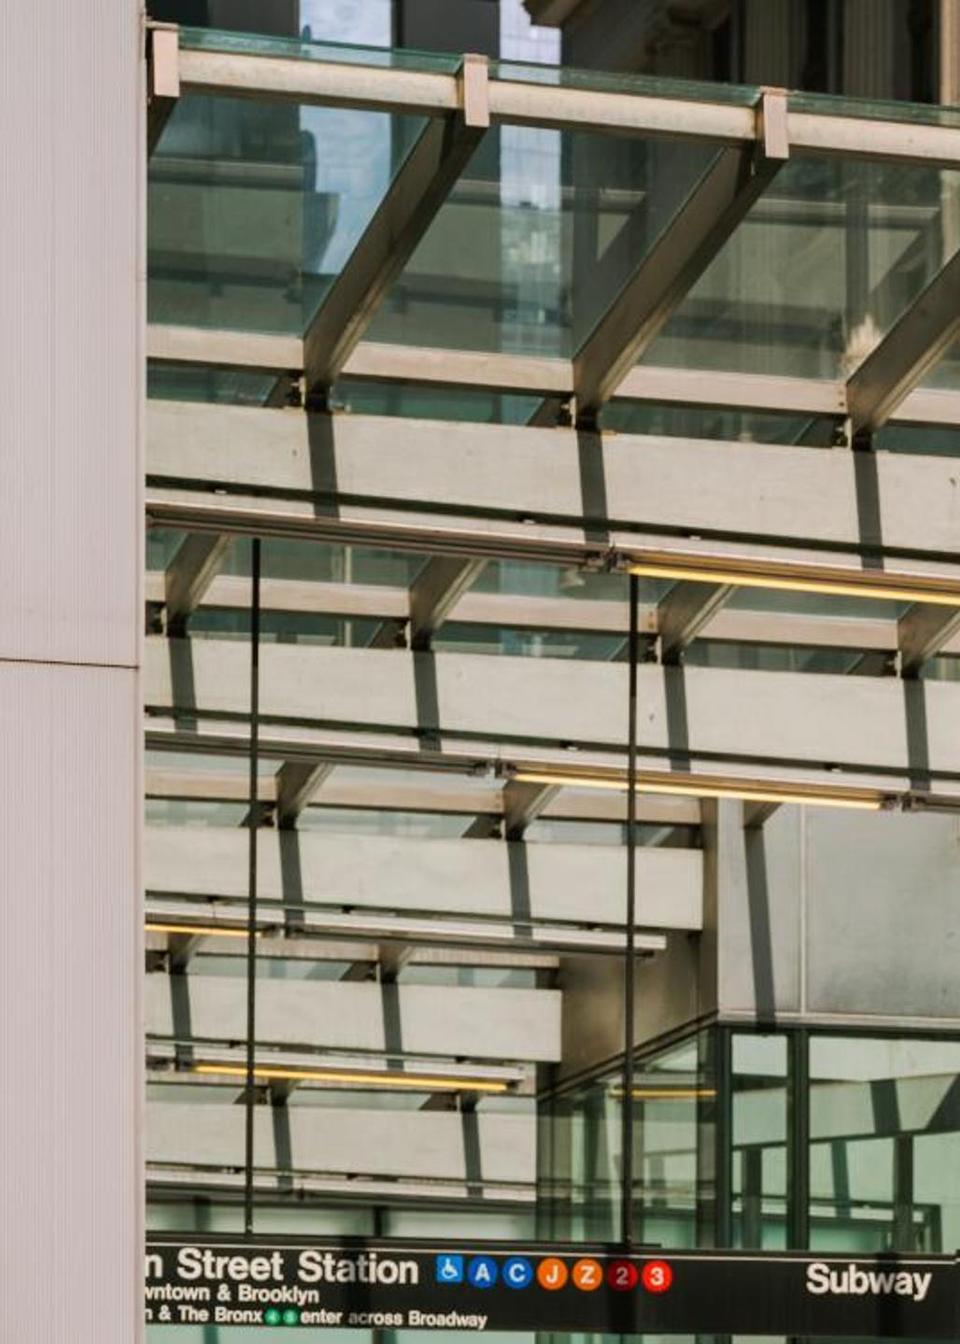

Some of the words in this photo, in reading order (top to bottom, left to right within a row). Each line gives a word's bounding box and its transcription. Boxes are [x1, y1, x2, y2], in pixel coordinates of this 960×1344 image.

[177, 1247, 284, 1281] Street
[297, 1250, 419, 1284] Station
[217, 1284, 231, 1301] &
[238, 1283, 320, 1306] Brooklyn
[806, 1262, 932, 1301] Subway
[159, 1305, 171, 1321] &
[177, 1305, 209, 1322] The
[215, 1306, 262, 1323] Bronx
[301, 1310, 342, 1325] enter
[349, 1312, 402, 1326] across
[408, 1310, 487, 1330] Broadway
